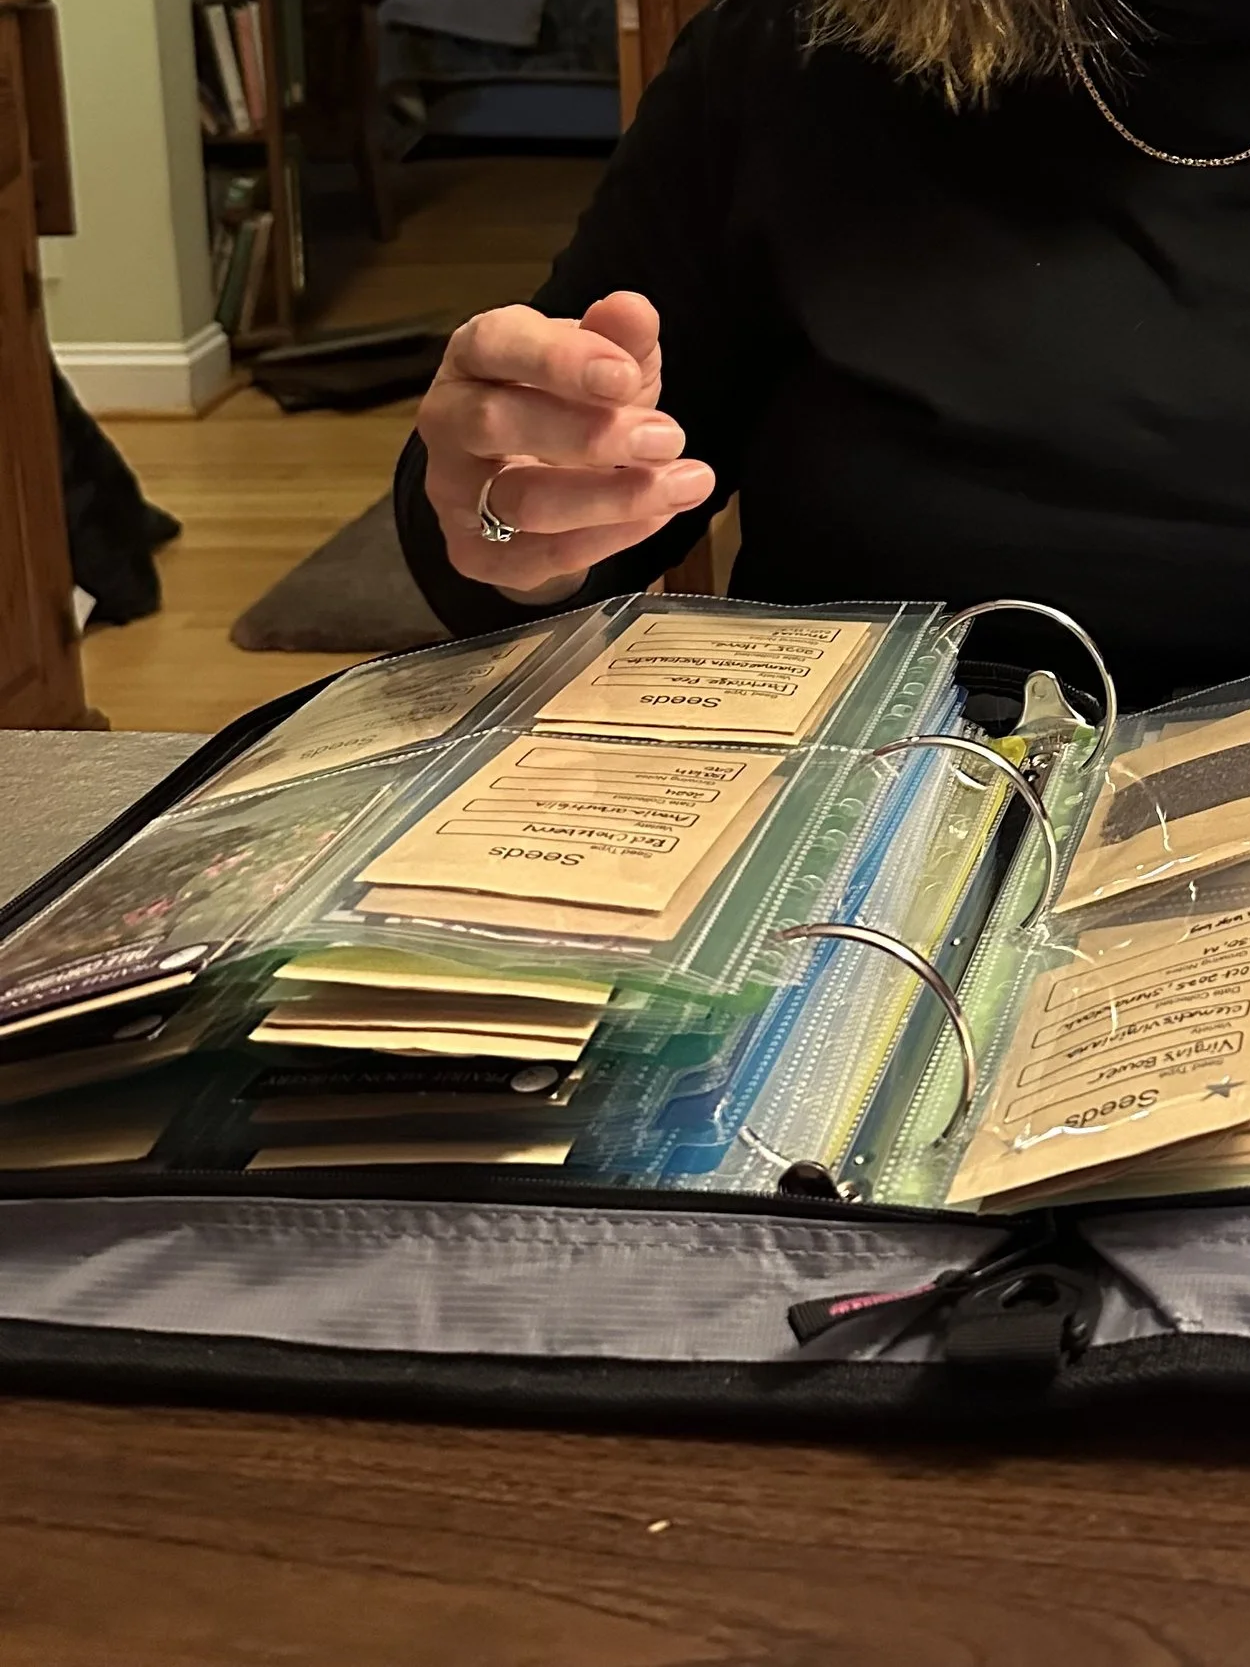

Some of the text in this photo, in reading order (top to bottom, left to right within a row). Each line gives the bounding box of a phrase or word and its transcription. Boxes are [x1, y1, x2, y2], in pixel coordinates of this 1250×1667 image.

[734, 652, 780, 660] Collected
[664, 676, 788, 692] Partridge Pea
[640, 695, 721, 708] Seeds
[300, 735, 377, 760] Seeds
[670, 775, 716, 786] Growing
[612, 794, 696, 808] Date Collected
[665, 788, 705, 799] 2024
[633, 821, 672, 833] Variety
[631, 836, 666, 848] Red
[488, 846, 584, 866] Seeds
[589, 844, 653, 860] Seed Type
[1164, 949, 1248, 976] Growing Notes
[1224, 965, 1250, 982] Oct
[1155, 986, 1240, 1009] Date Collected
[1190, 1021, 1232, 1034] Variety
[1086, 1057, 1158, 1084] Bower
[1158, 1065, 1186, 1079] Type
[1064, 1088, 1160, 1128] Seeds
